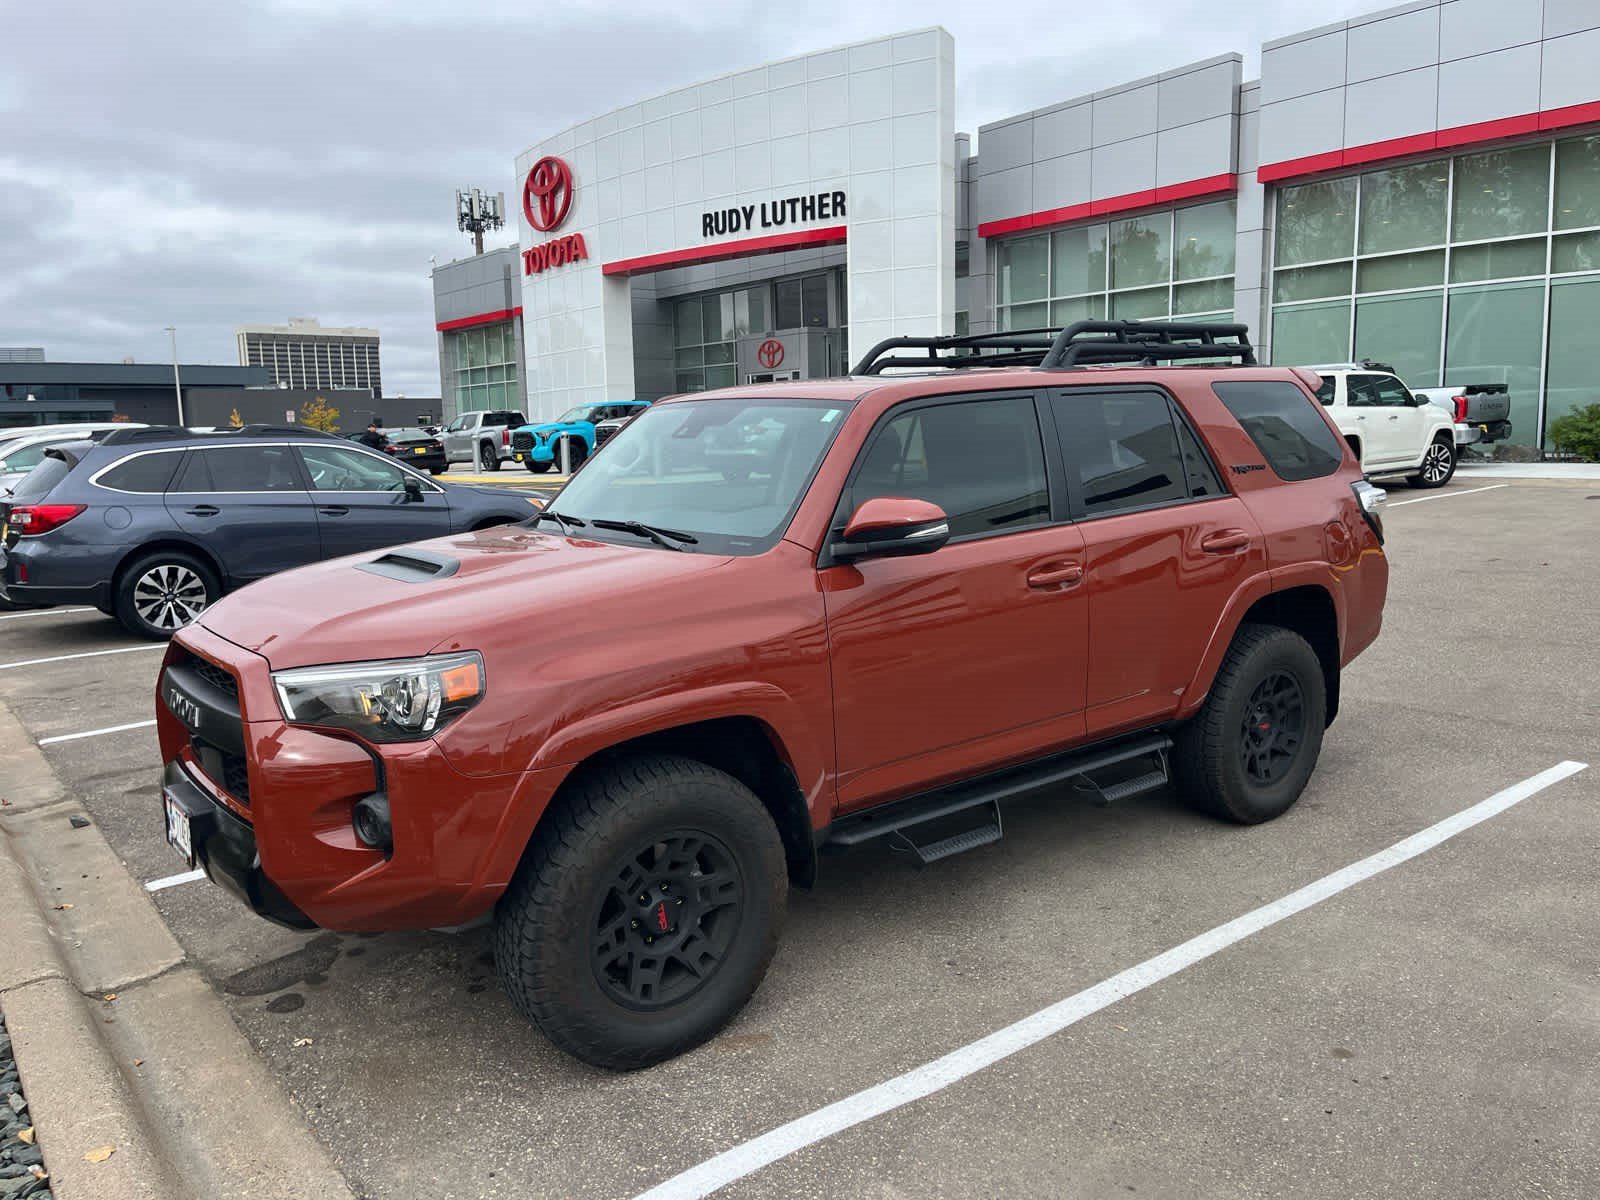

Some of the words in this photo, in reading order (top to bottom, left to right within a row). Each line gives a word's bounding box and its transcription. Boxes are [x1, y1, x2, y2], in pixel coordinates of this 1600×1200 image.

[702, 205, 755, 238] RUDY
[760, 190, 847, 228] LUTHER
[521, 232, 588, 276] TOYOTA
